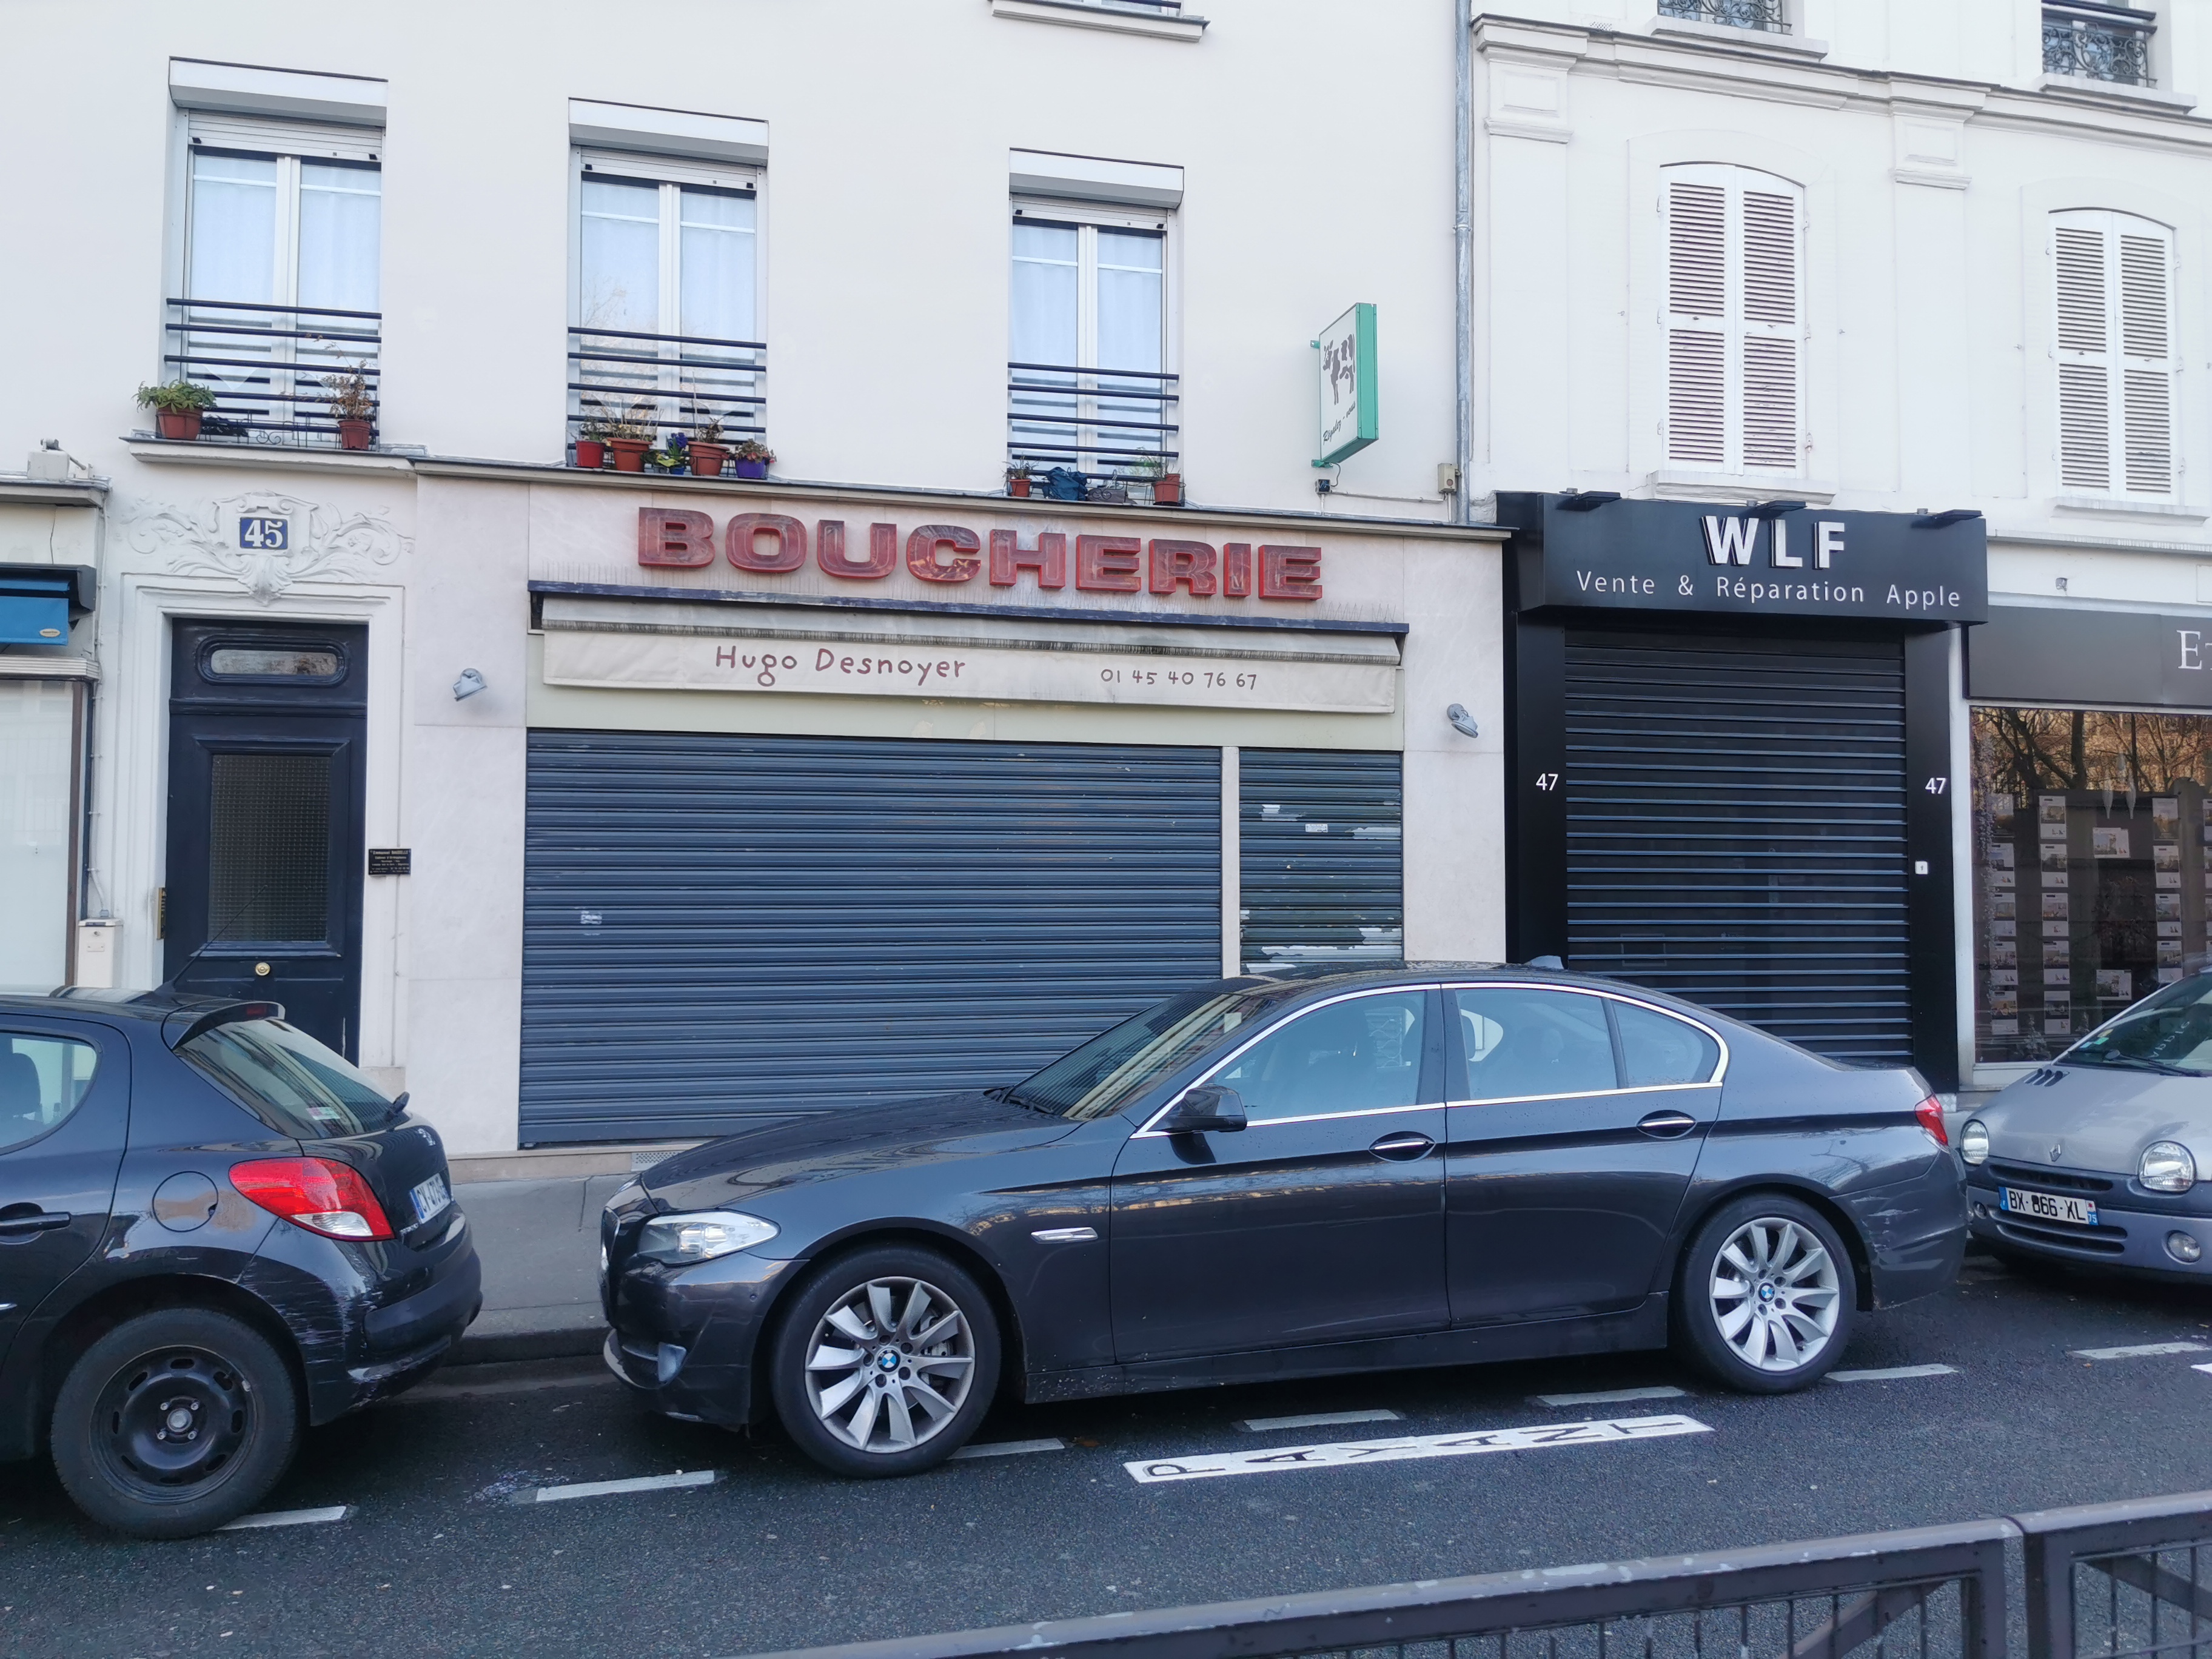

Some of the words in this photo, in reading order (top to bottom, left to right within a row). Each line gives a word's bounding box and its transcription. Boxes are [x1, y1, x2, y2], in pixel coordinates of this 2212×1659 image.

[244, 519, 283, 548] 45
[638, 506, 1323, 600] BOUCHERIE
[1701, 515, 1846, 569] WLF
[1577, 571, 1655, 595] Vente
[1678, 574, 1694, 597] &
[1717, 576, 1864, 604] Réparation
[1886, 584, 1961, 611] Apple
[716, 645, 798, 687] Hugo
[815, 648, 965, 686] Desnoyer
[2176, 629, 2212, 671] E
[1100, 668, 1121, 683] 01
[1131, 669, 1158, 685] 45
[1168, 671, 1194, 685] 40
[1203, 672, 1226, 688] 76
[1236, 672, 1257, 690] 67
[1535, 773, 1559, 792] 47
[1925, 777, 1947, 796] 47
[2088, 1213, 2097, 1224] 75
[1145, 1419, 1687, 1477] PAYANT
